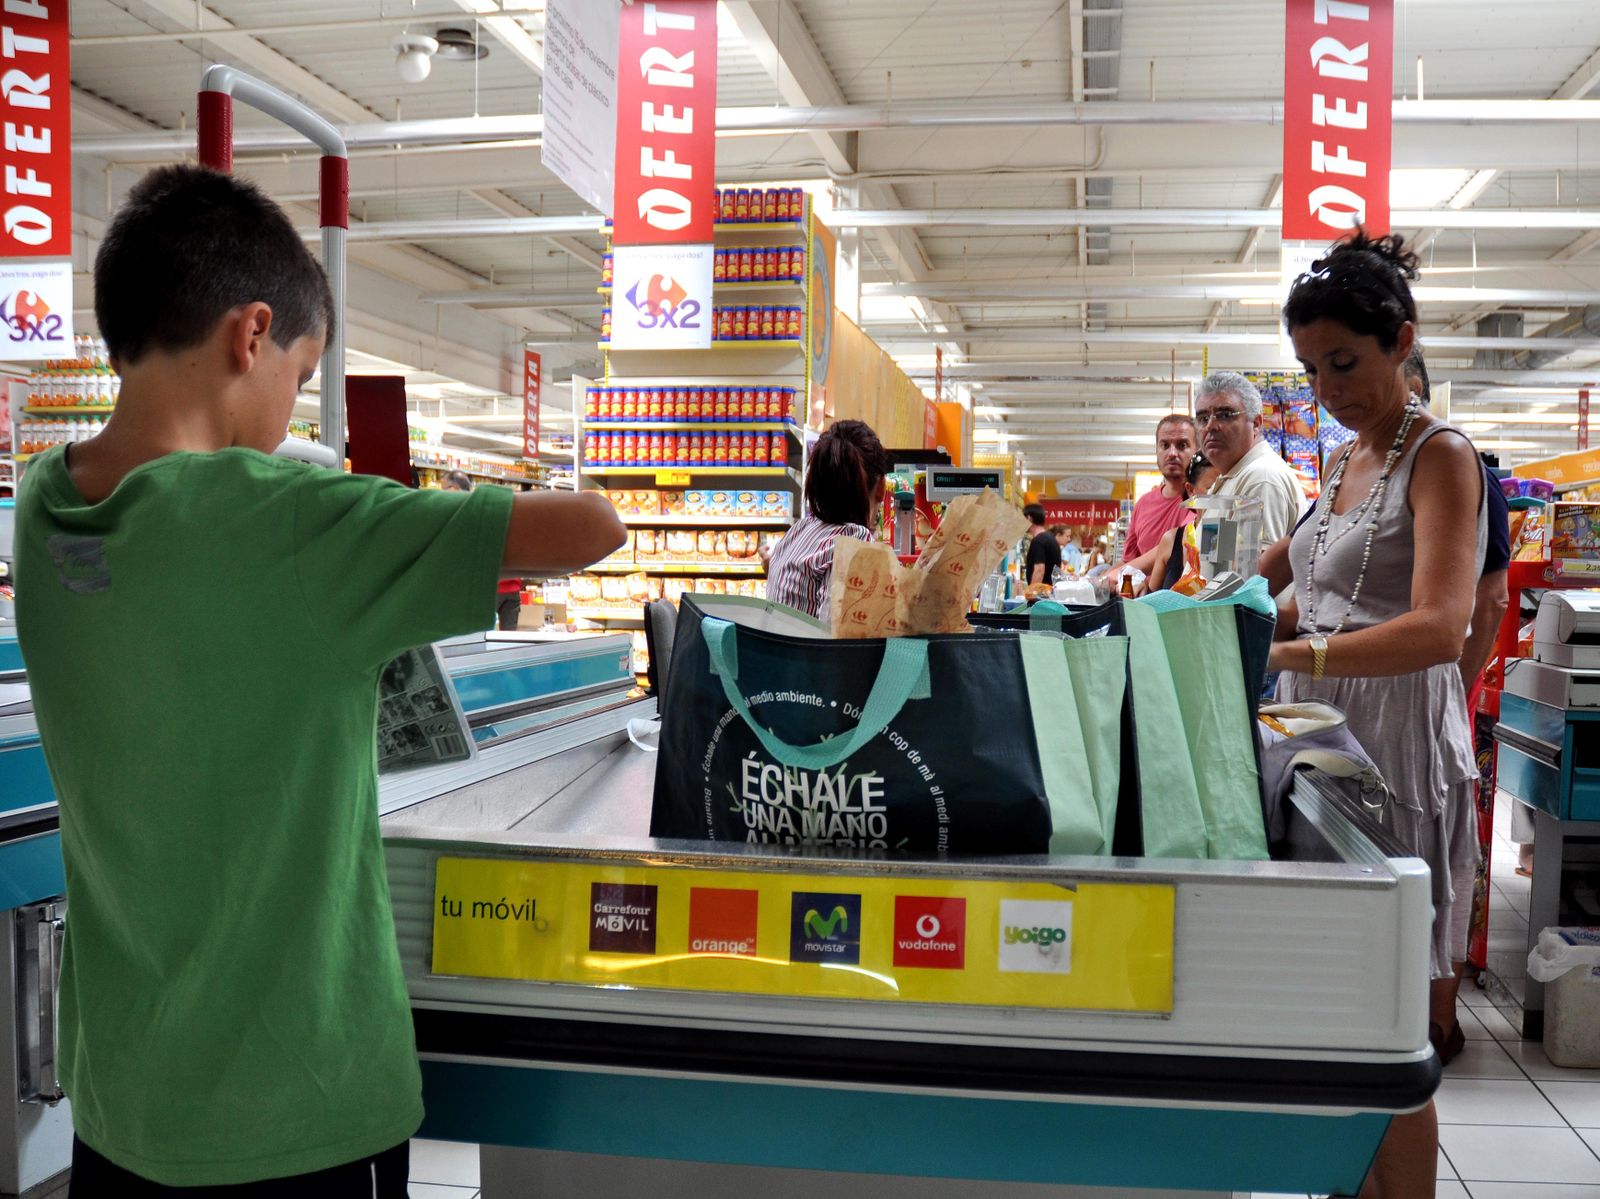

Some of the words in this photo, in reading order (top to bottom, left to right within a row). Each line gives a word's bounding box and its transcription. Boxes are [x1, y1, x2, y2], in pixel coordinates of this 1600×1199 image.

[637, 299, 700, 329] 3x2
[8, 314, 64, 342] 3x2
[517, 360, 538, 454] OFERTA
[750, 690, 775, 705] medio
[775, 690, 826, 708] ambiente.
[702, 740, 717, 774] Échale
[712, 724, 723, 743] una
[888, 731, 908, 750] cop
[907, 749, 921, 765] de
[742, 751, 887, 813] ÉCHALE
[918, 764, 936, 782] mà
[930, 785, 944, 796] al
[743, 799, 795, 836] UNA
[801, 812, 887, 839] MANO
[935, 796, 950, 824] medi
[441, 895, 462, 917] tu
[472, 896, 537, 922] móvil
[594, 903, 651, 916] Carrefour
[899, 940, 956, 951] vodafone
[1004, 926, 1066, 946] yoigo
[692, 939, 748, 955] orange
[804, 941, 847, 953] movistar
